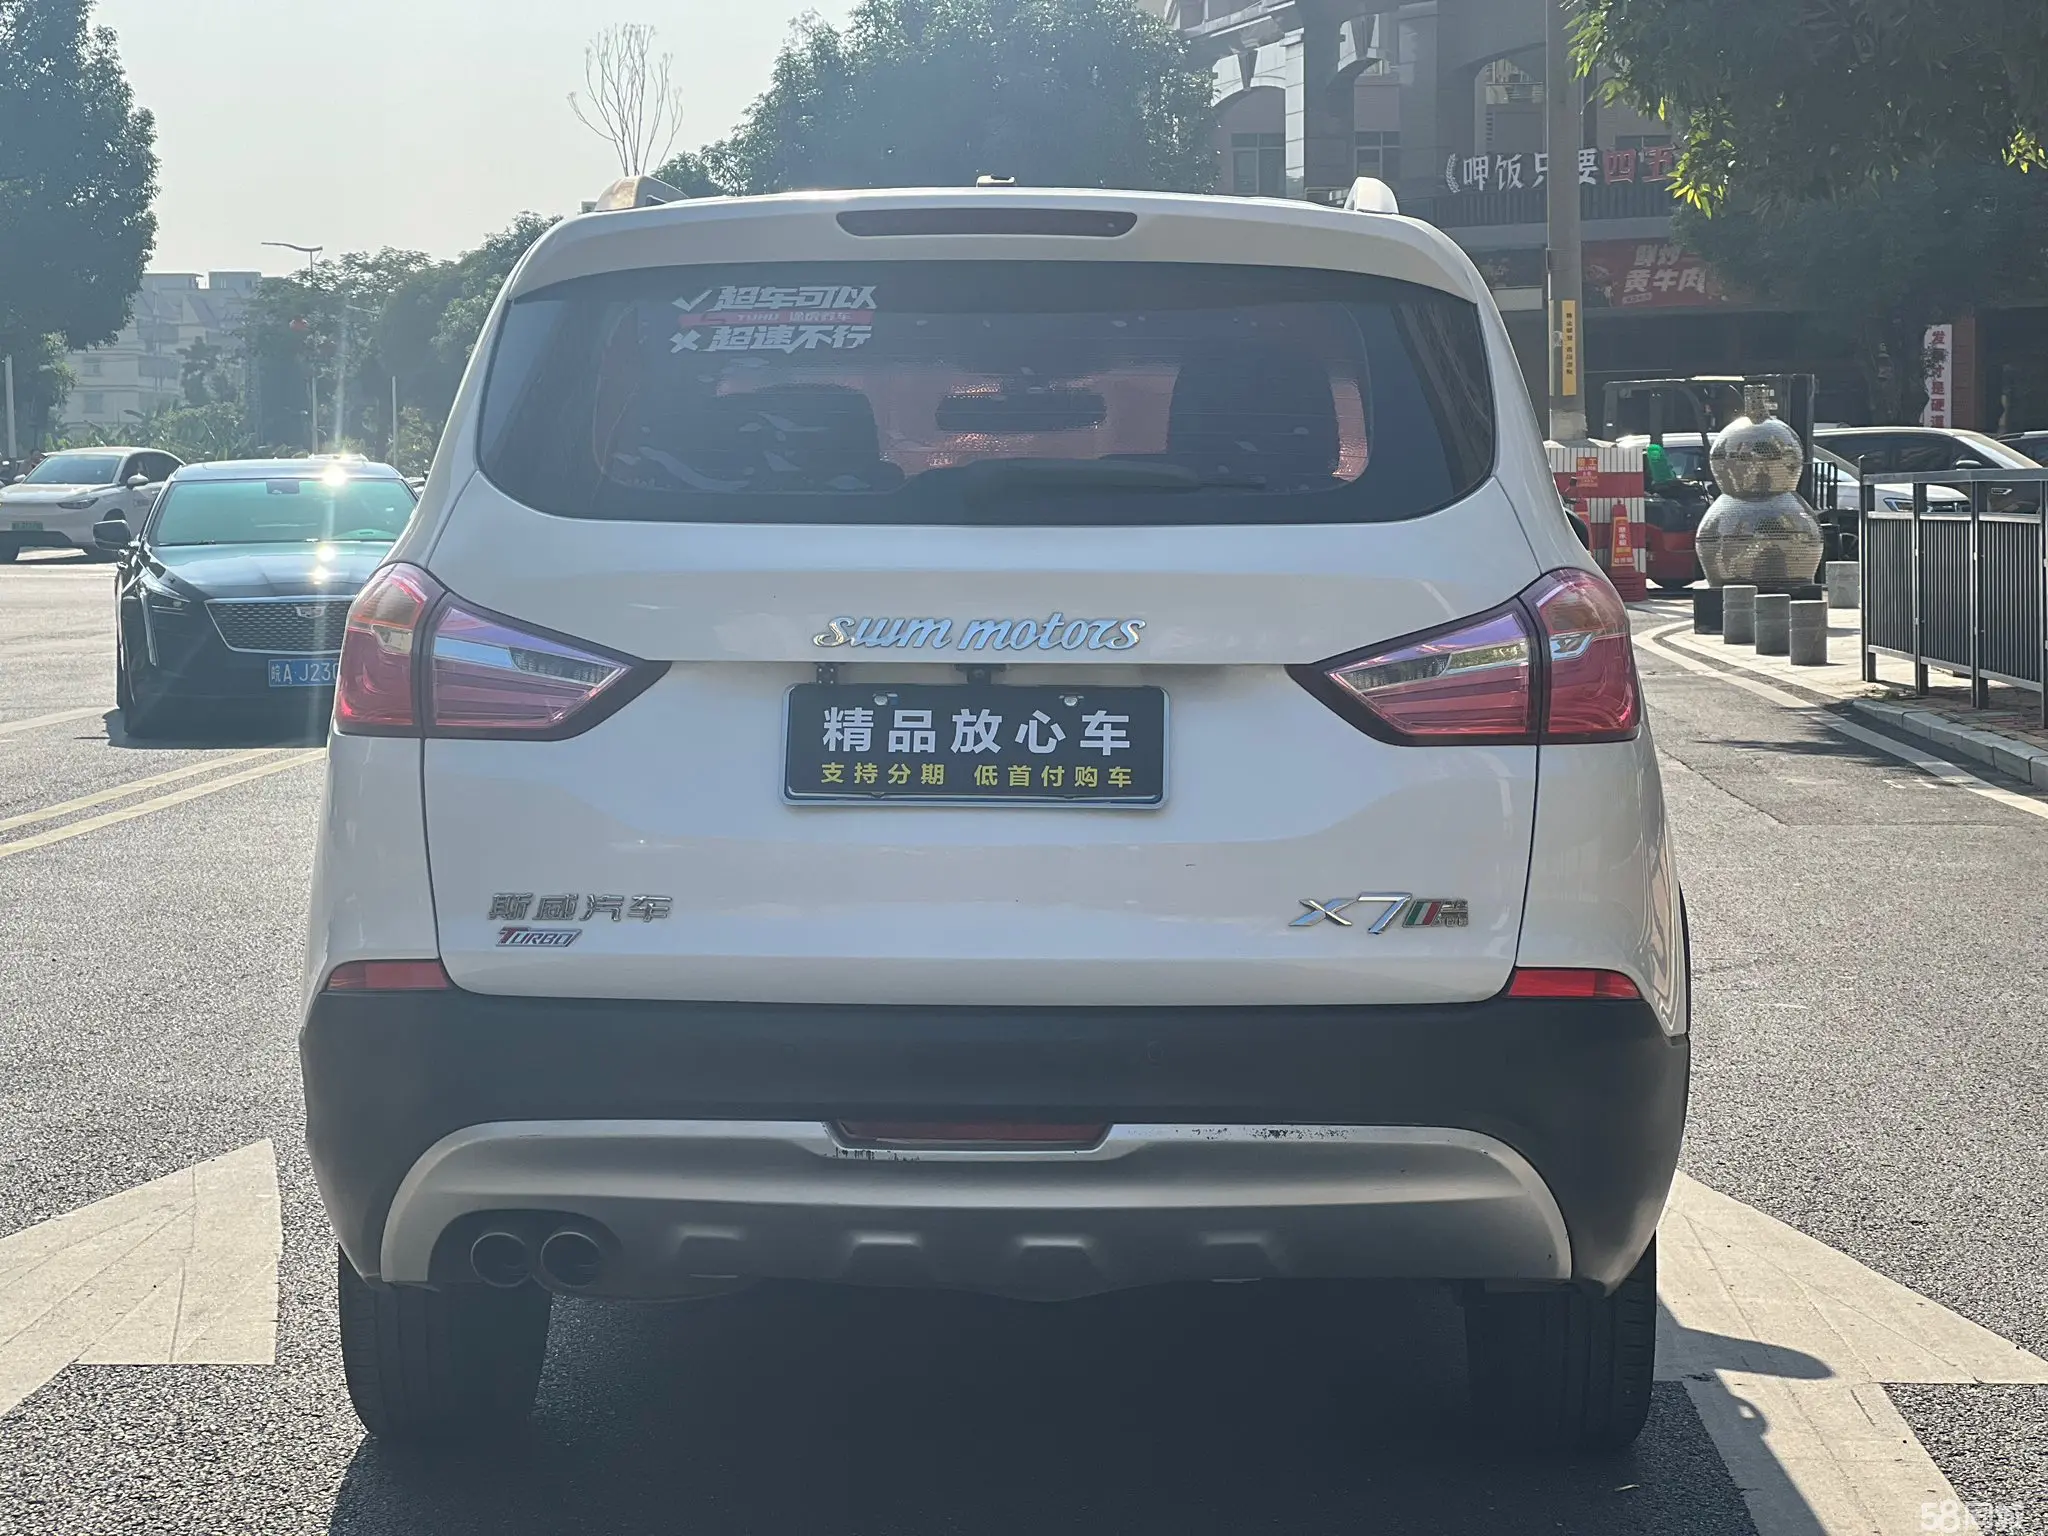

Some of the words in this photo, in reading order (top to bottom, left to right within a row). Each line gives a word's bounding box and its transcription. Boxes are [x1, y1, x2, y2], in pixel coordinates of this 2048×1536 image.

[1623, 266, 1706, 294] 黄牛肉
[706, 285, 878, 311] 超车可以
[700, 325, 872, 354] 超速不行
[822, 706, 1131, 756] 精品放心车
[821, 763, 945, 786] 支持分期
[974, 764, 1132, 788] 低首付购车
[487, 893, 673, 923] 斯威汽车
[498, 927, 577, 946] TURBO
